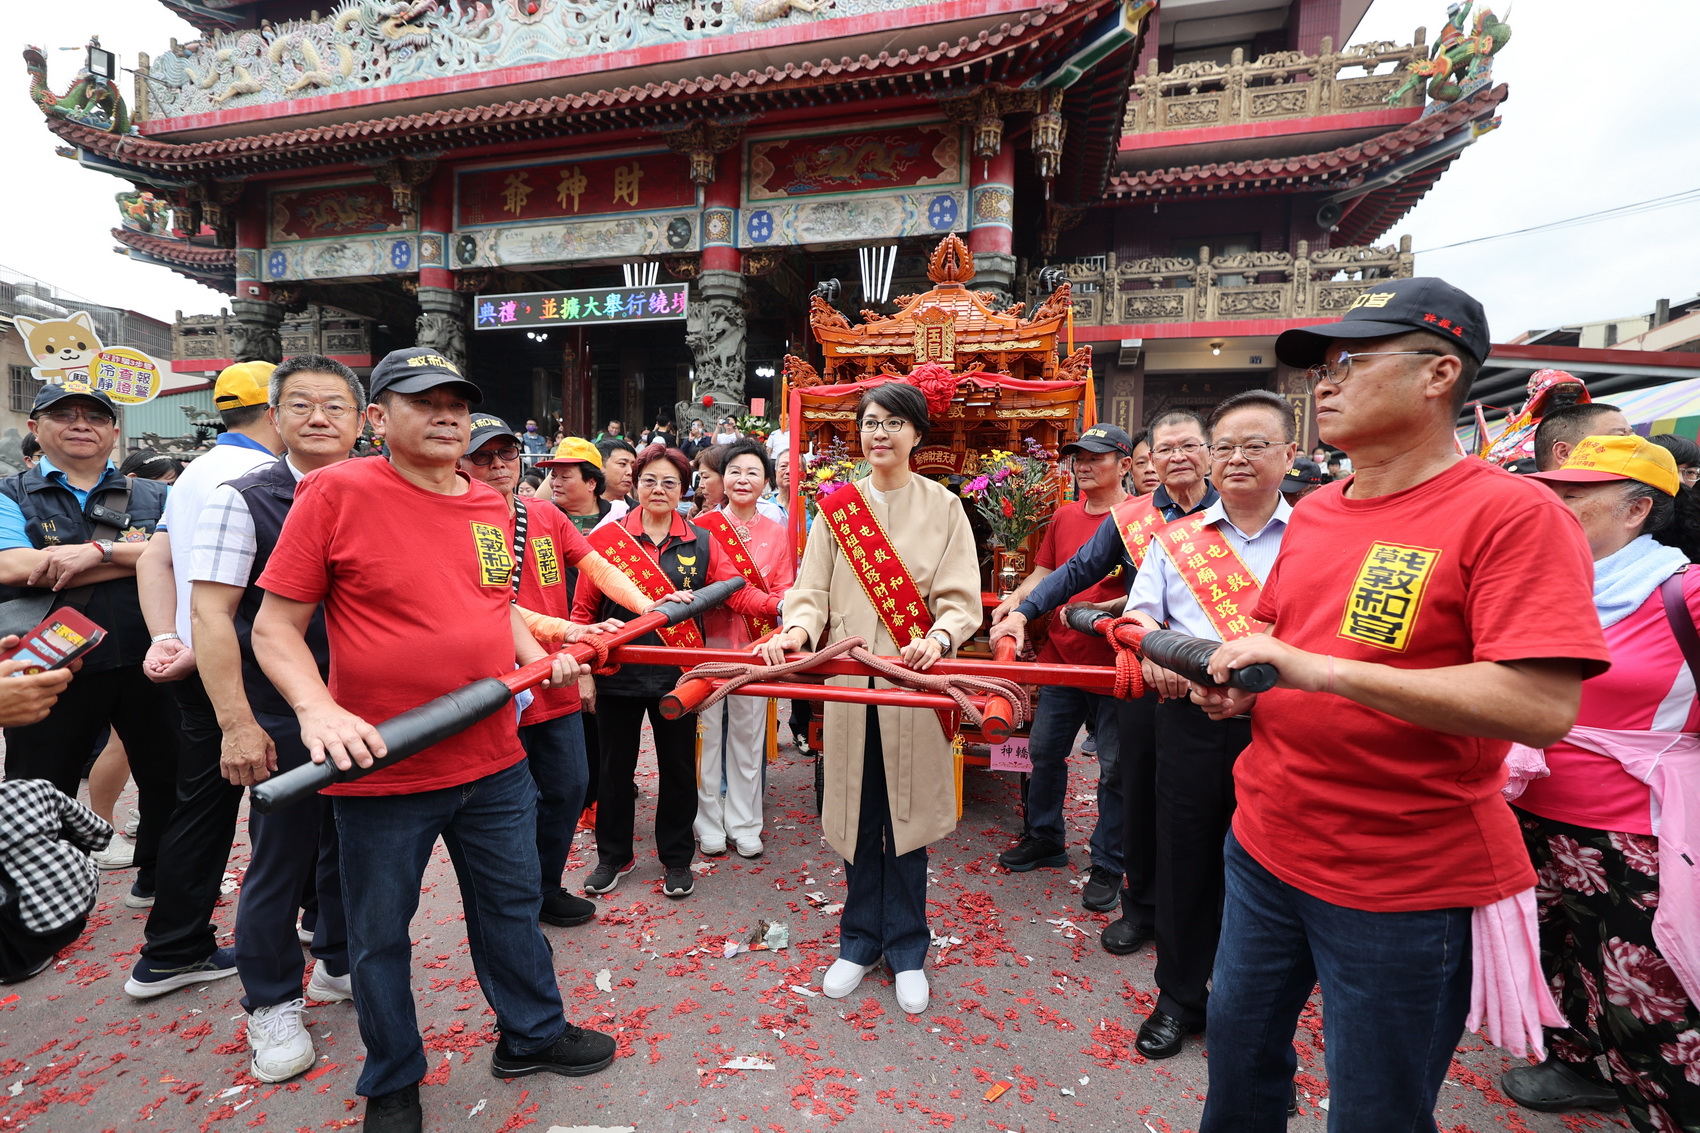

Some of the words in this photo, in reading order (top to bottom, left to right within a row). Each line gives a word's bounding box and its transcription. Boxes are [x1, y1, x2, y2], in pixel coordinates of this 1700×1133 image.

[501, 161, 644, 216] 財神爺
[479, 538, 513, 585] 敦和宮
[538, 547, 561, 586] 敦和宮
[1169, 528, 1253, 639] 開台祖廟五路財
[1190, 519, 1262, 624] 草屯敦
[1372, 547, 1426, 572] 草屯
[1350, 566, 1419, 645] 敦和宮
